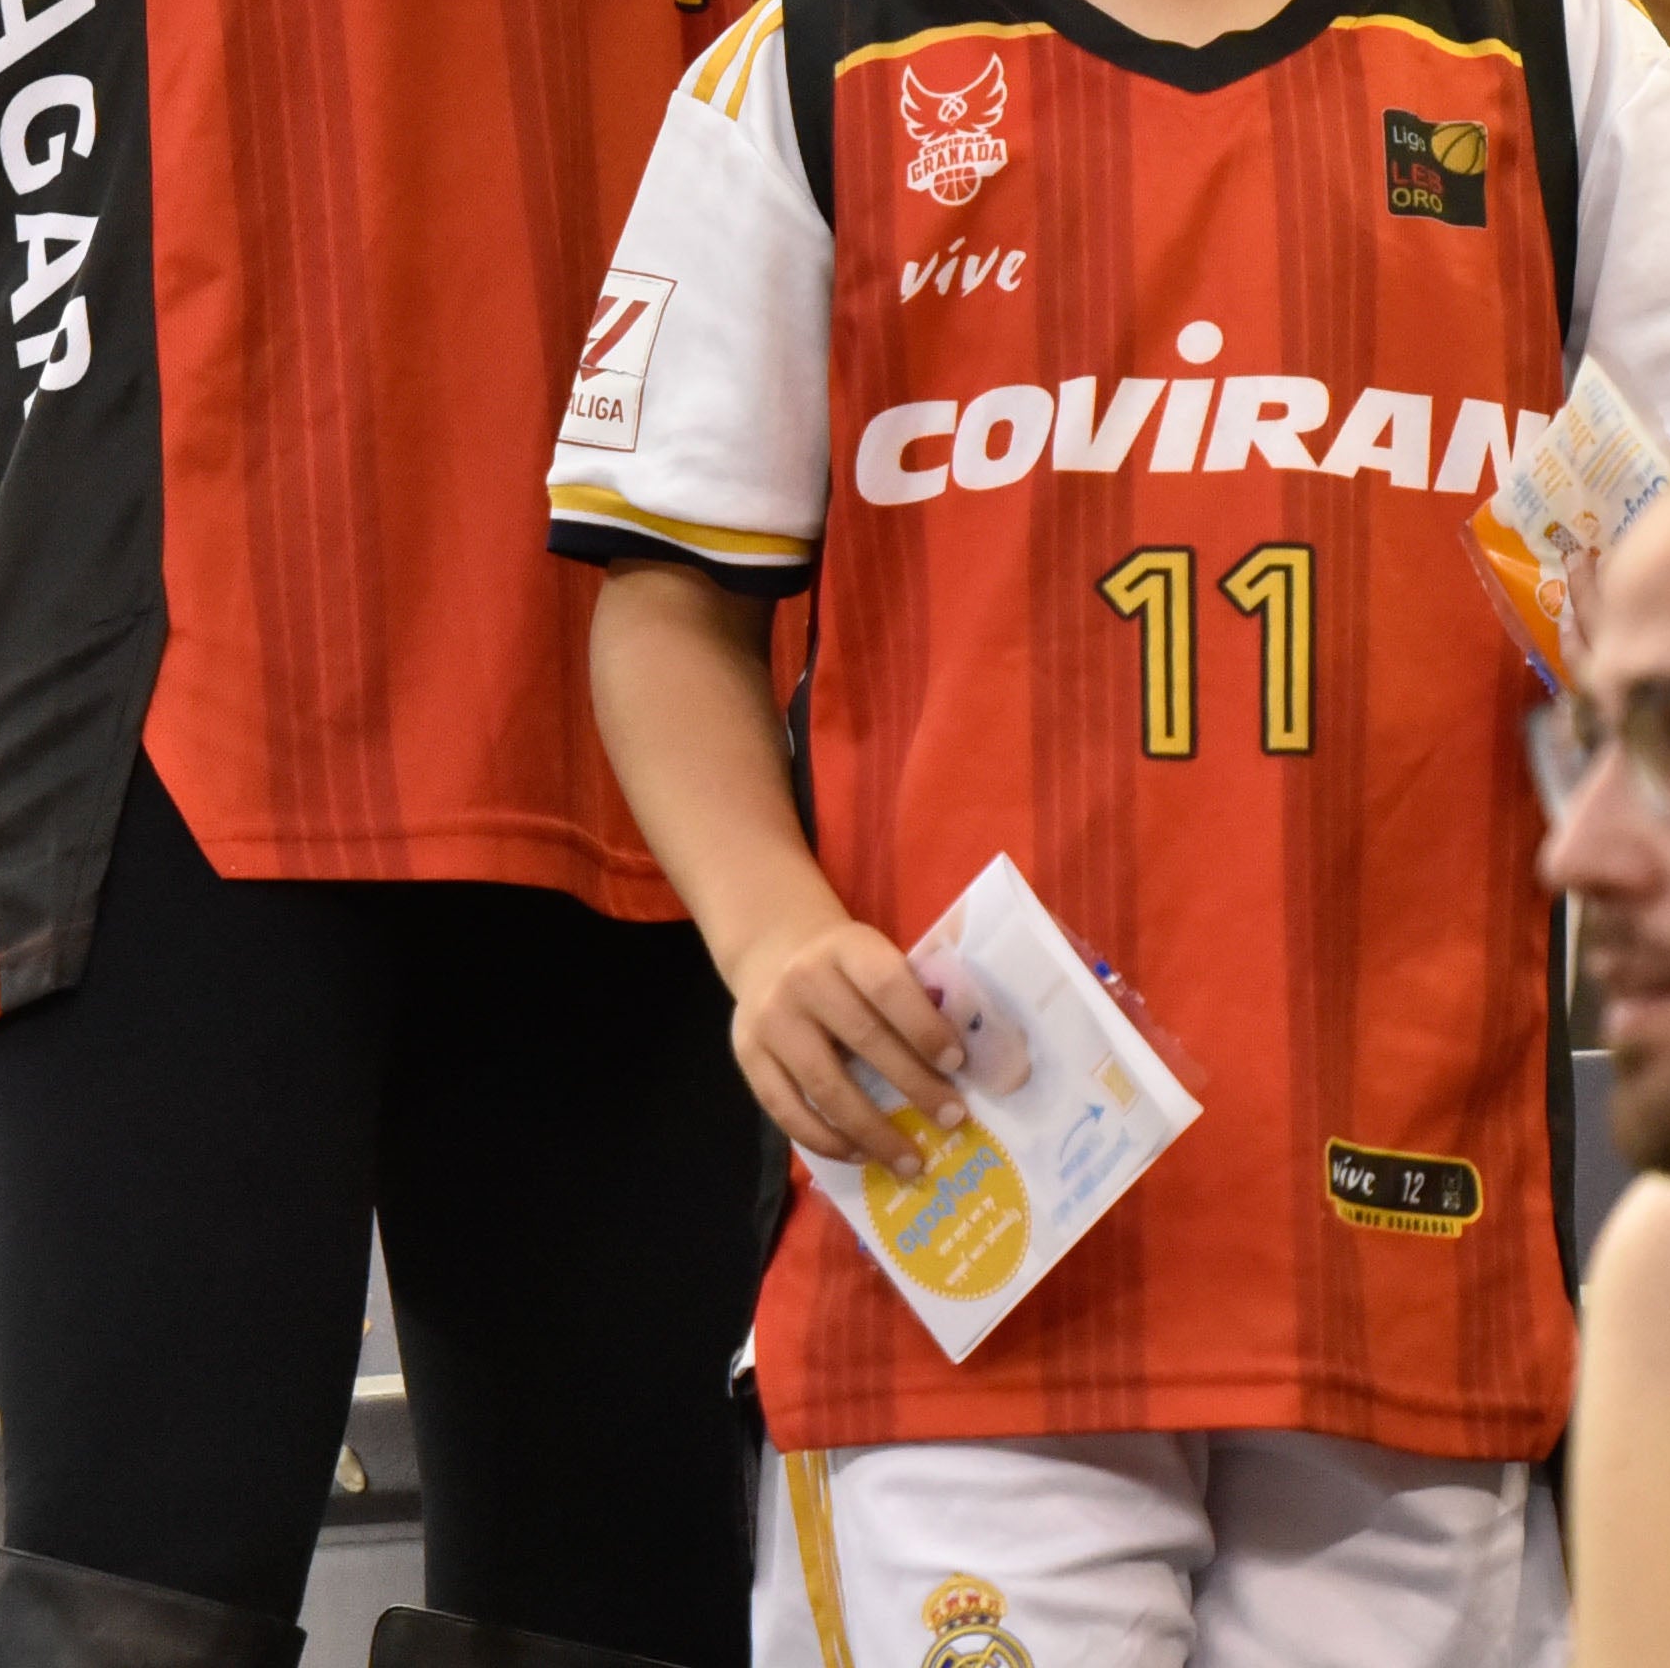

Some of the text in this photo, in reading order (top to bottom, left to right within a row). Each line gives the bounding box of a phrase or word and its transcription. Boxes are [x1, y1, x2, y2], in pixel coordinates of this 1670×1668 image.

[1392, 124, 1426, 152] Liga
[911, 142, 1003, 183] GRANADA
[1391, 160, 1443, 194] LEB
[1392, 187, 1443, 213] ORO
[1096, 544, 1317, 759] 11
[1401, 1170, 1425, 1205] 12
